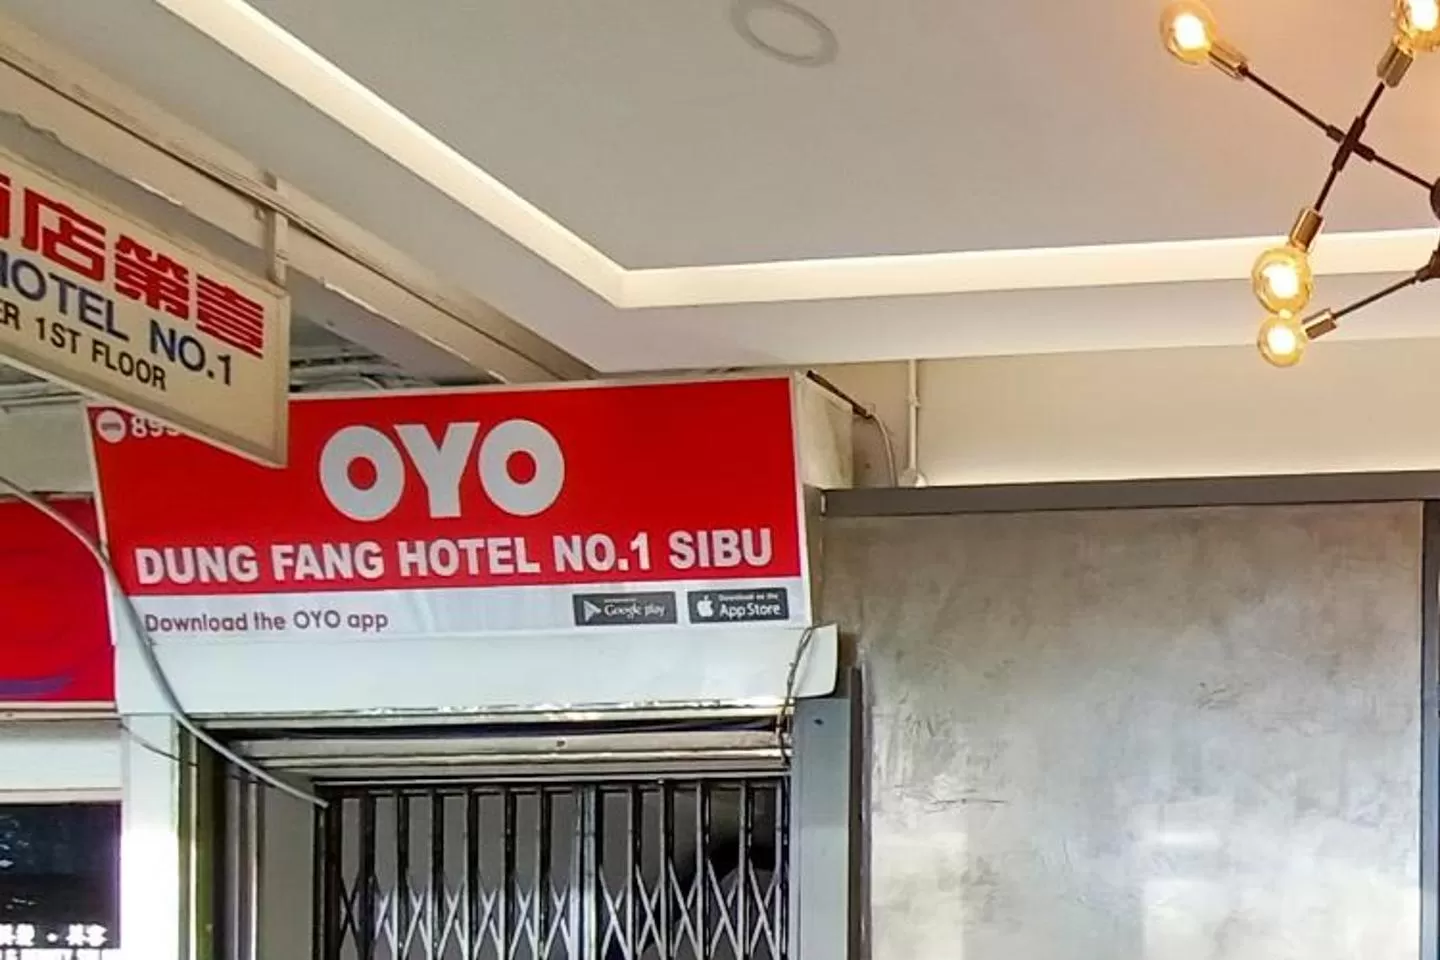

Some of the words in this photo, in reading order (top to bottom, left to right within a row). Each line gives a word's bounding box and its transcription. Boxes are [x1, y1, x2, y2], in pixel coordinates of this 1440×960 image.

[0, 172, 264, 359] 店第壹
[35, 316, 82, 354] 1ST
[91, 338, 167, 392] FLOOR
[149, 318, 232, 387] NO.1
[319, 418, 566, 522] OYO
[134, 545, 260, 585] DUNG
[271, 540, 385, 582] FANG
[397, 535, 541, 578] HOTEL
[552, 531, 651, 573] NO.1
[667, 527, 773, 570] SIBU
[145, 611, 248, 633] Download
[253, 610, 286, 631] the
[292, 608, 341, 630] OYO
[347, 611, 389, 632] app
[603, 603, 642, 620] Google
[644, 603, 666, 618] play
[719, 603, 746, 620] App
[746, 602, 781, 616] Store
